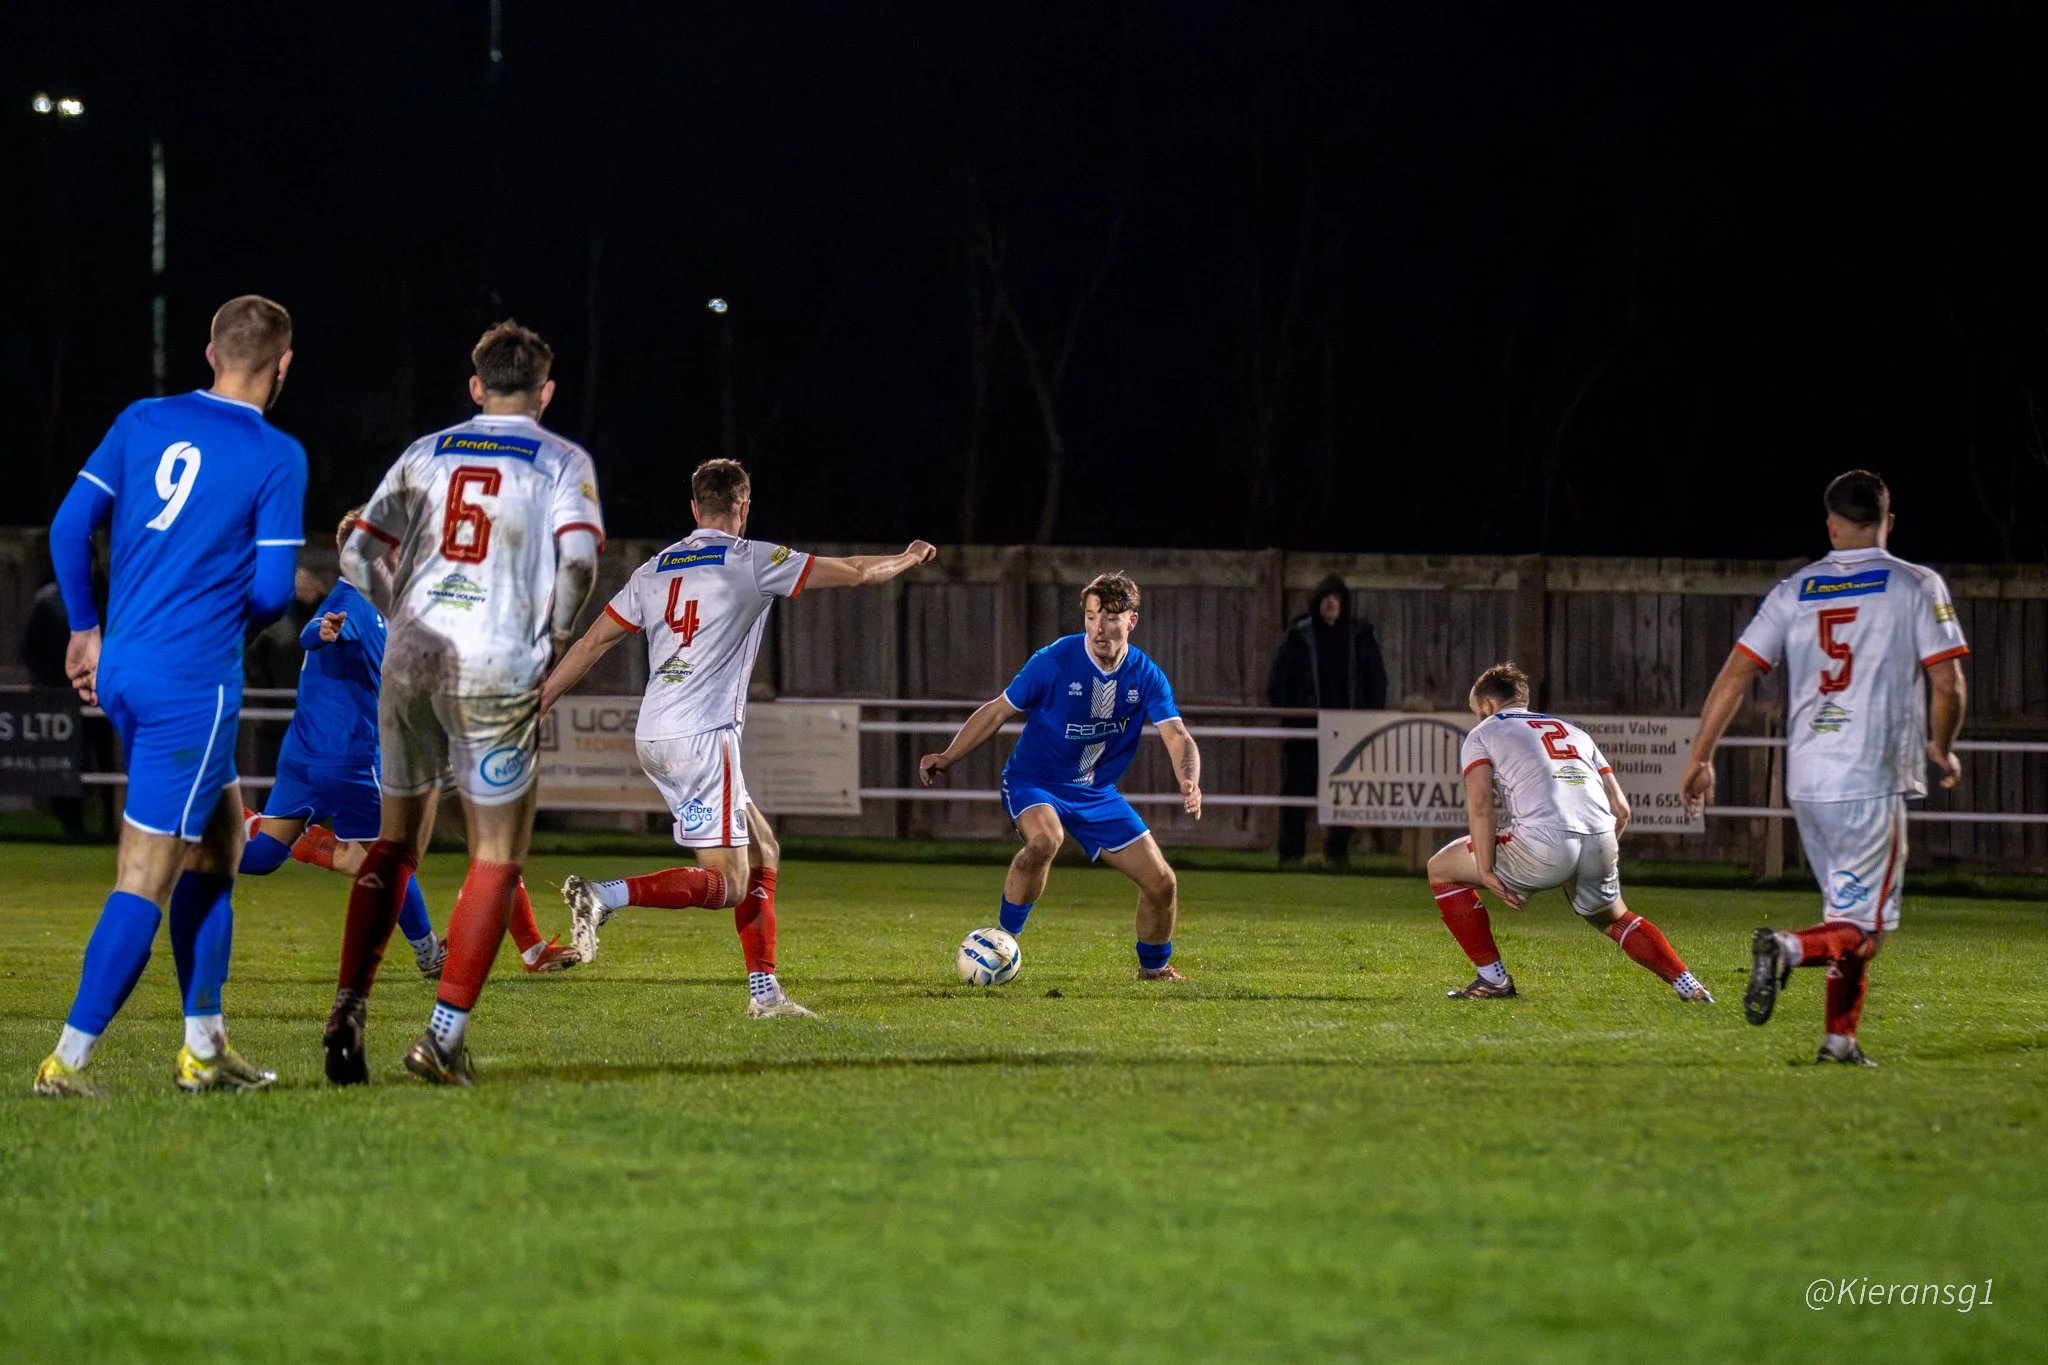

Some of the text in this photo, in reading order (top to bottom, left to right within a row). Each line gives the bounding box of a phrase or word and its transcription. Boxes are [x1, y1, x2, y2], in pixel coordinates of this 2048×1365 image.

[146, 441, 201, 532] 9
[440, 465, 502, 565] 6
[664, 576, 700, 648] 4
[1818, 606, 1859, 695] 5
[22, 712, 74, 741] LTD
[1527, 720, 1580, 761] 2
[1628, 721, 1667, 735] Valve
[1650, 740, 1677, 755] and
[689, 805, 713, 814] Fibre
[1655, 793, 1682, 808] 655
[681, 811, 713, 822] Nova
